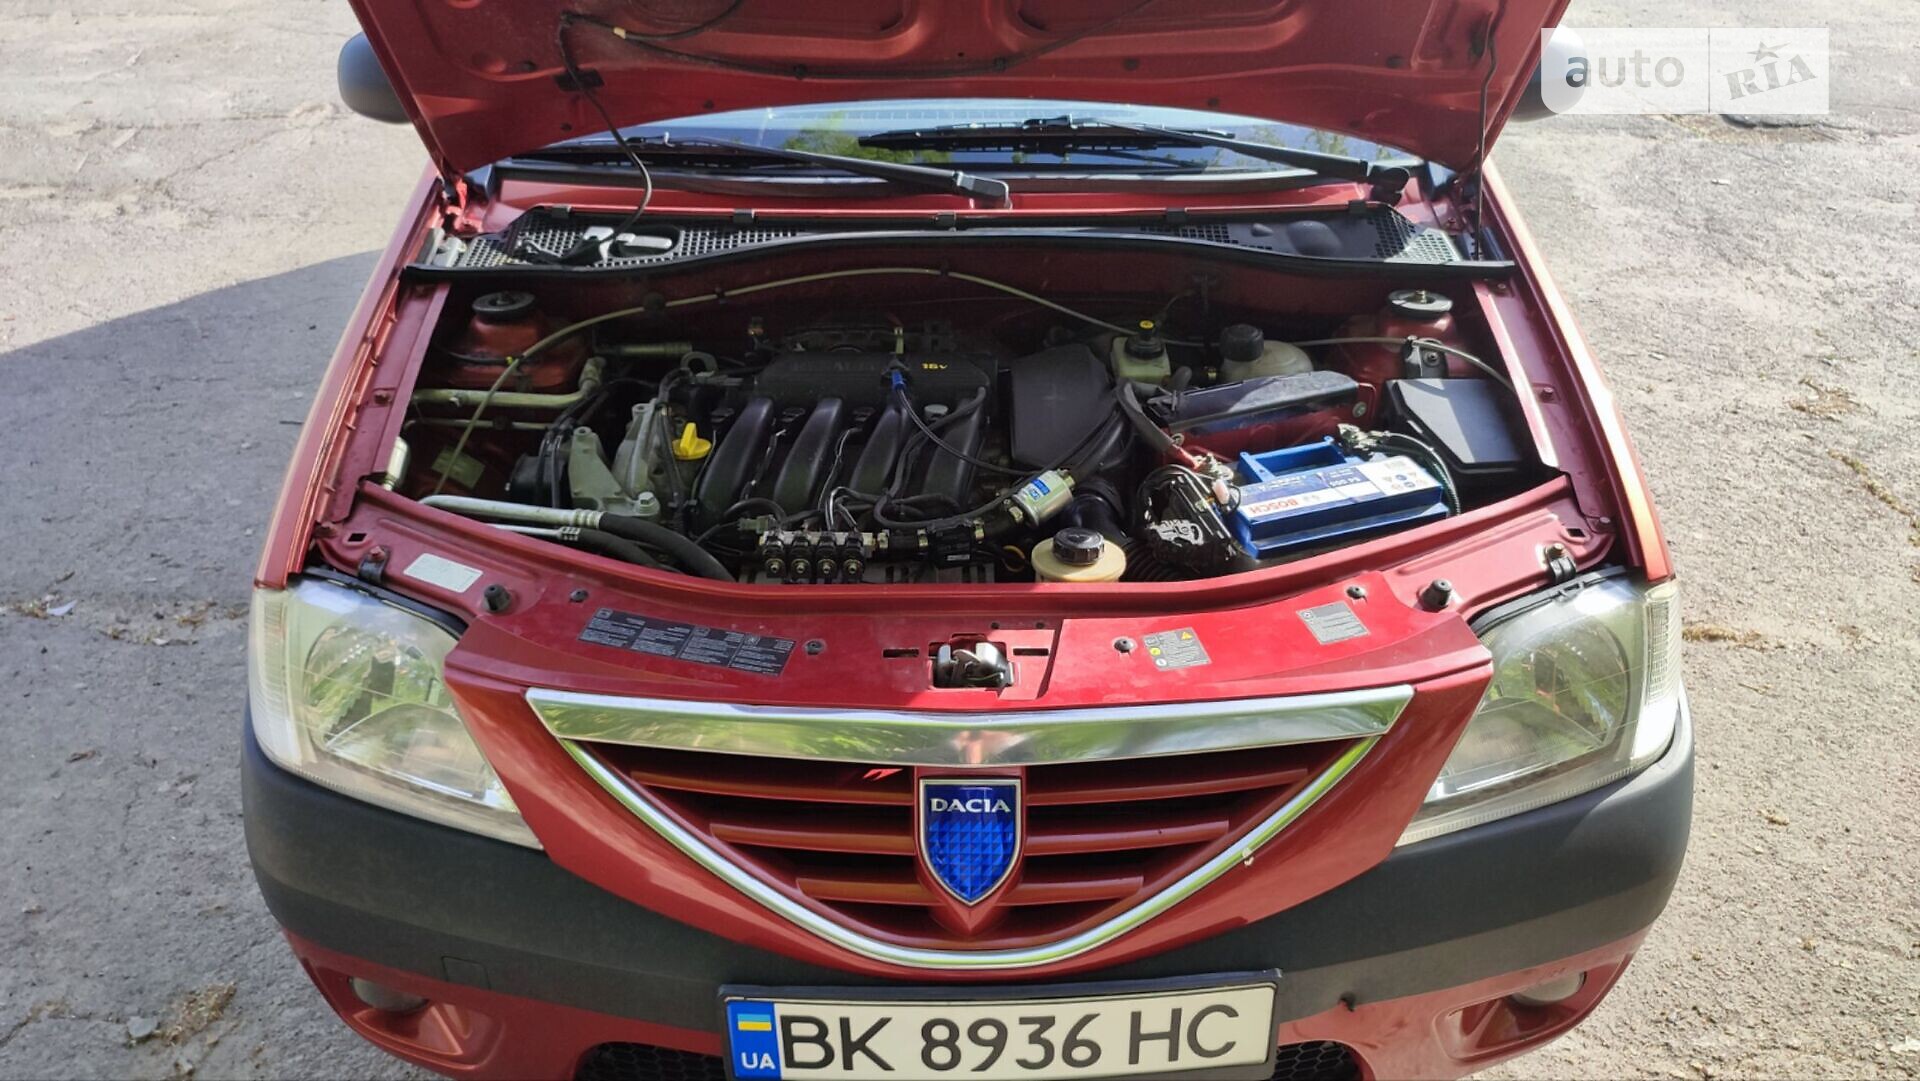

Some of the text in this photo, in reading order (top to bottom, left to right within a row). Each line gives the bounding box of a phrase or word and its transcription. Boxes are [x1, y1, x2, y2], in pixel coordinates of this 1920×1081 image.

[1249, 498, 1299, 514] BOSCH
[930, 798, 1011, 813] DACIA
[780, 1004, 1239, 1073] BK 8936 HC
[741, 1052, 776, 1070] UA
